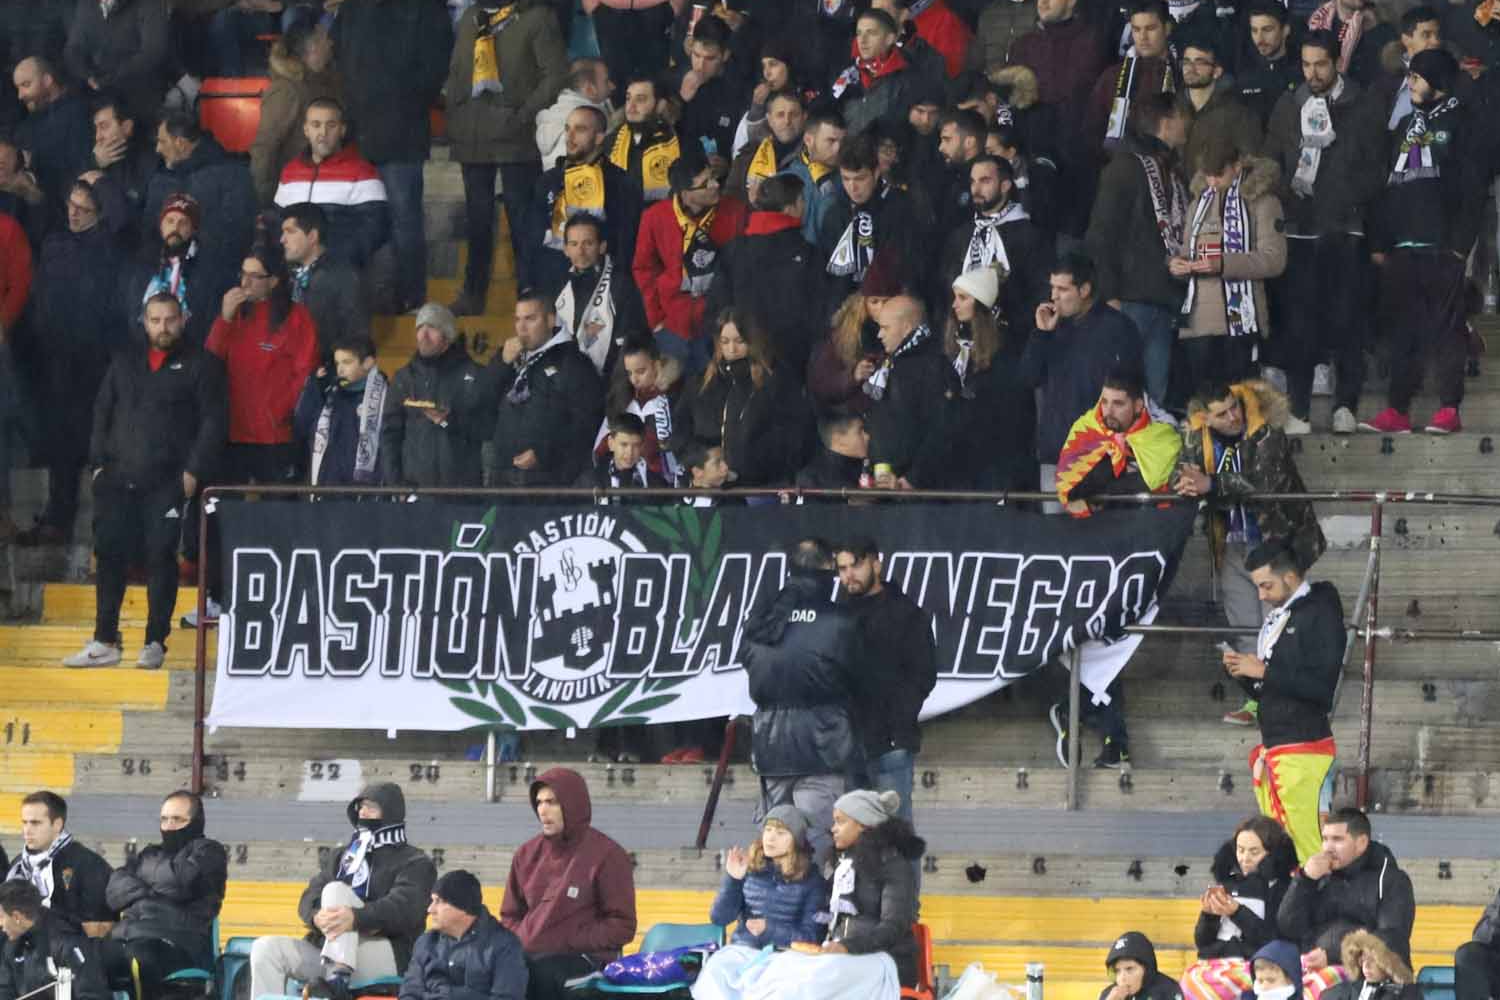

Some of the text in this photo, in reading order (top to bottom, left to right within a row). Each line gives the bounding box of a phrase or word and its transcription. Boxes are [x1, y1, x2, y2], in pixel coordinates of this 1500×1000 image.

[228, 523, 538, 679] BASTIÓN
[790, 608, 817, 623] DAD
[310, 762, 342, 781] 22
